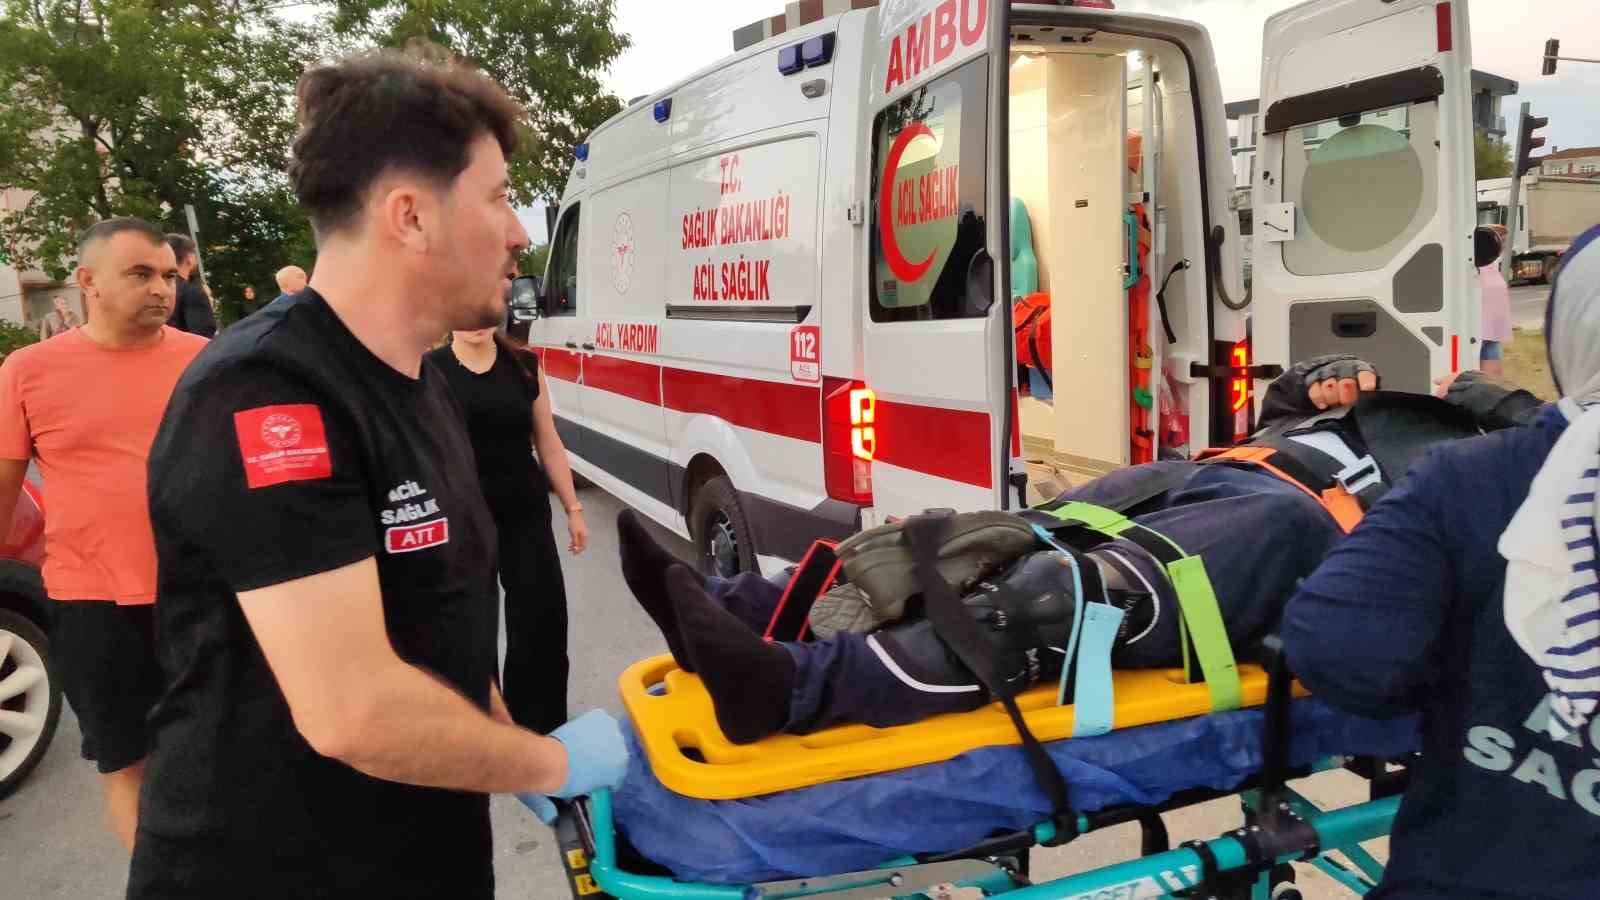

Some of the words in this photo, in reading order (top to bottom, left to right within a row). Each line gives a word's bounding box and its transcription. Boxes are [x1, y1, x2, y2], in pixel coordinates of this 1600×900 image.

[884, 0, 988, 94] AMBU
[682, 205, 718, 250] SAĞLIK
[720, 190, 790, 246] BAKANLIĞI
[693, 256, 718, 300] ACİL
[721, 253, 770, 300] SAĞLIK
[617, 323, 658, 353] YARDIM
[794, 331, 816, 360] 112
[381, 498, 441, 525] SAĞLIK
[401, 527, 437, 547] ATT
